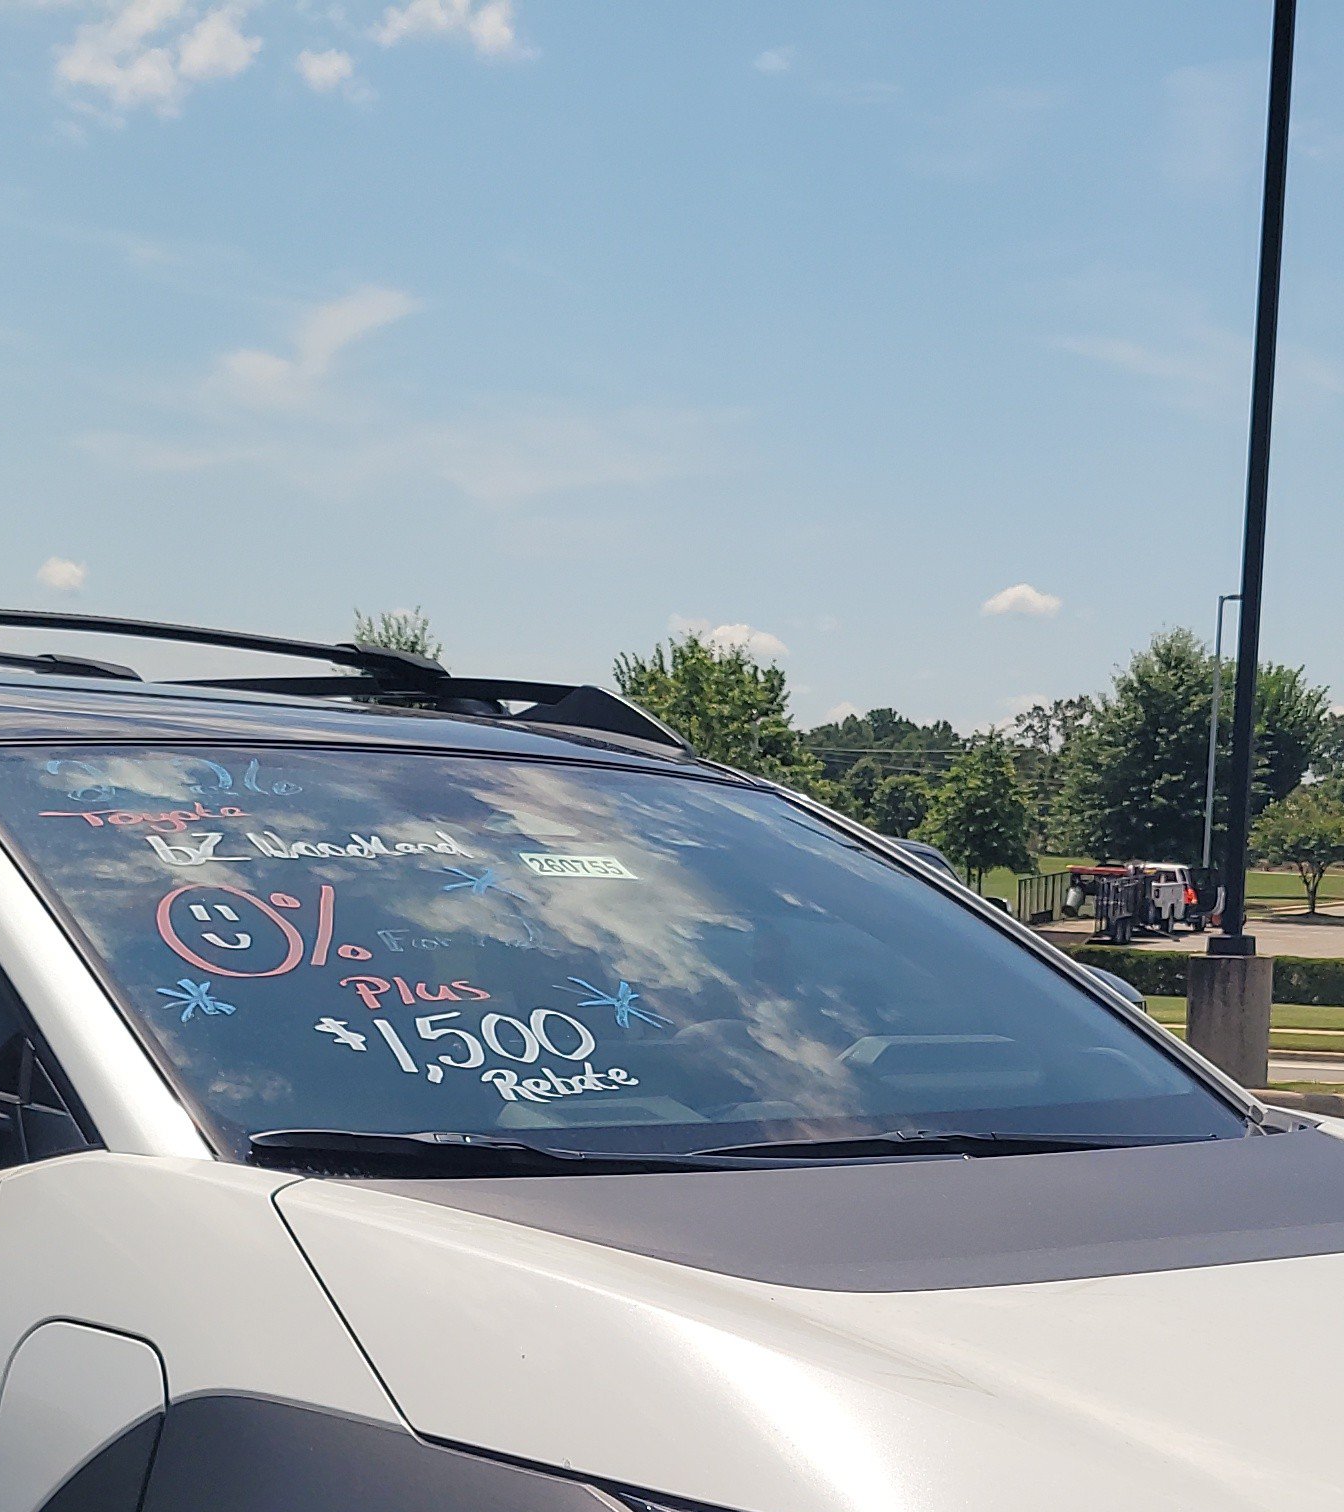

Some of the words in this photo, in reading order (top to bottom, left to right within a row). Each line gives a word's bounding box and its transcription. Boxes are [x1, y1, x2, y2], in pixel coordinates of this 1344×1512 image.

[37, 801, 252, 833] Toyota
[528, 857, 624, 876] 260755
[340, 976, 491, 1009] Plus
[314, 1008, 596, 1084] $1,500
[481, 1062, 640, 1103] Rebate
